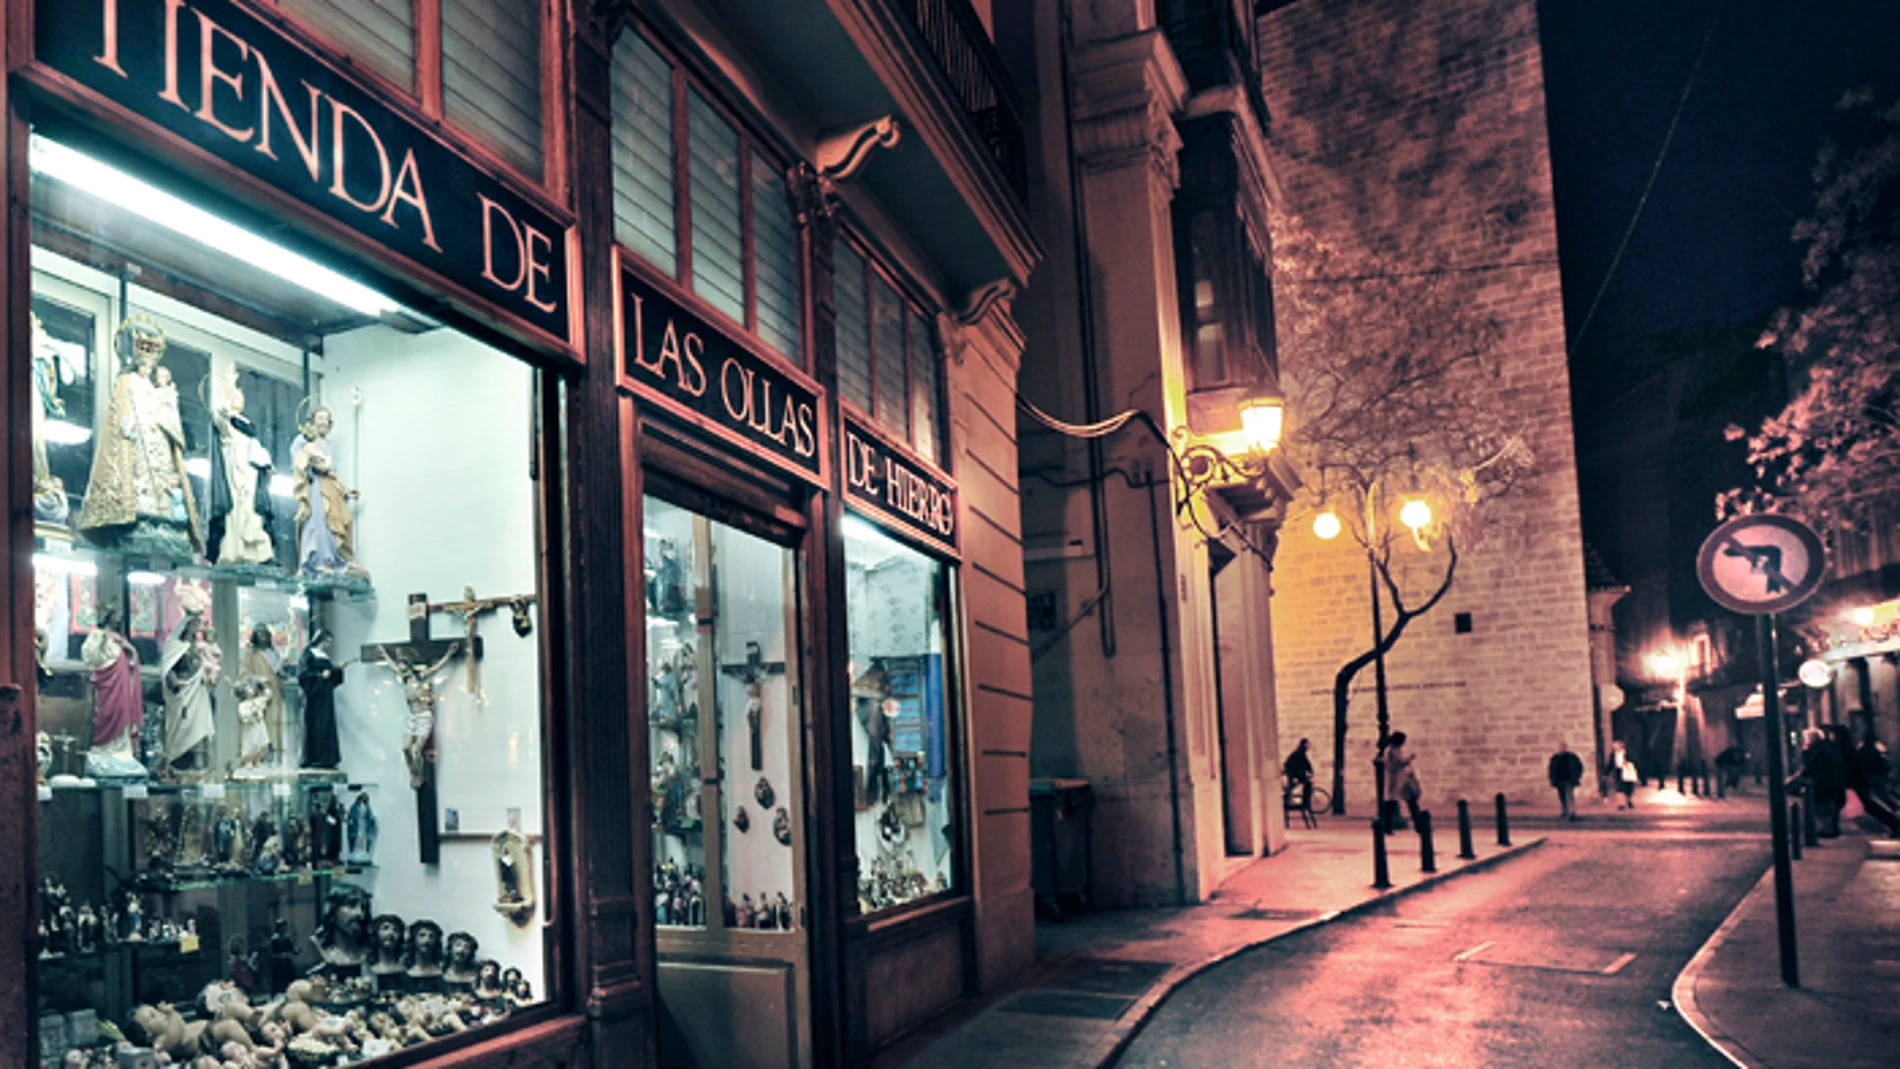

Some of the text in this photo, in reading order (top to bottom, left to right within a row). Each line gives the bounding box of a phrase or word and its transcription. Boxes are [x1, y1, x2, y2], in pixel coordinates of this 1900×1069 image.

[477, 192, 557, 313] DE
[632, 292, 815, 457] LAS OLLAS
[847, 431, 954, 536] DE HIERRO
